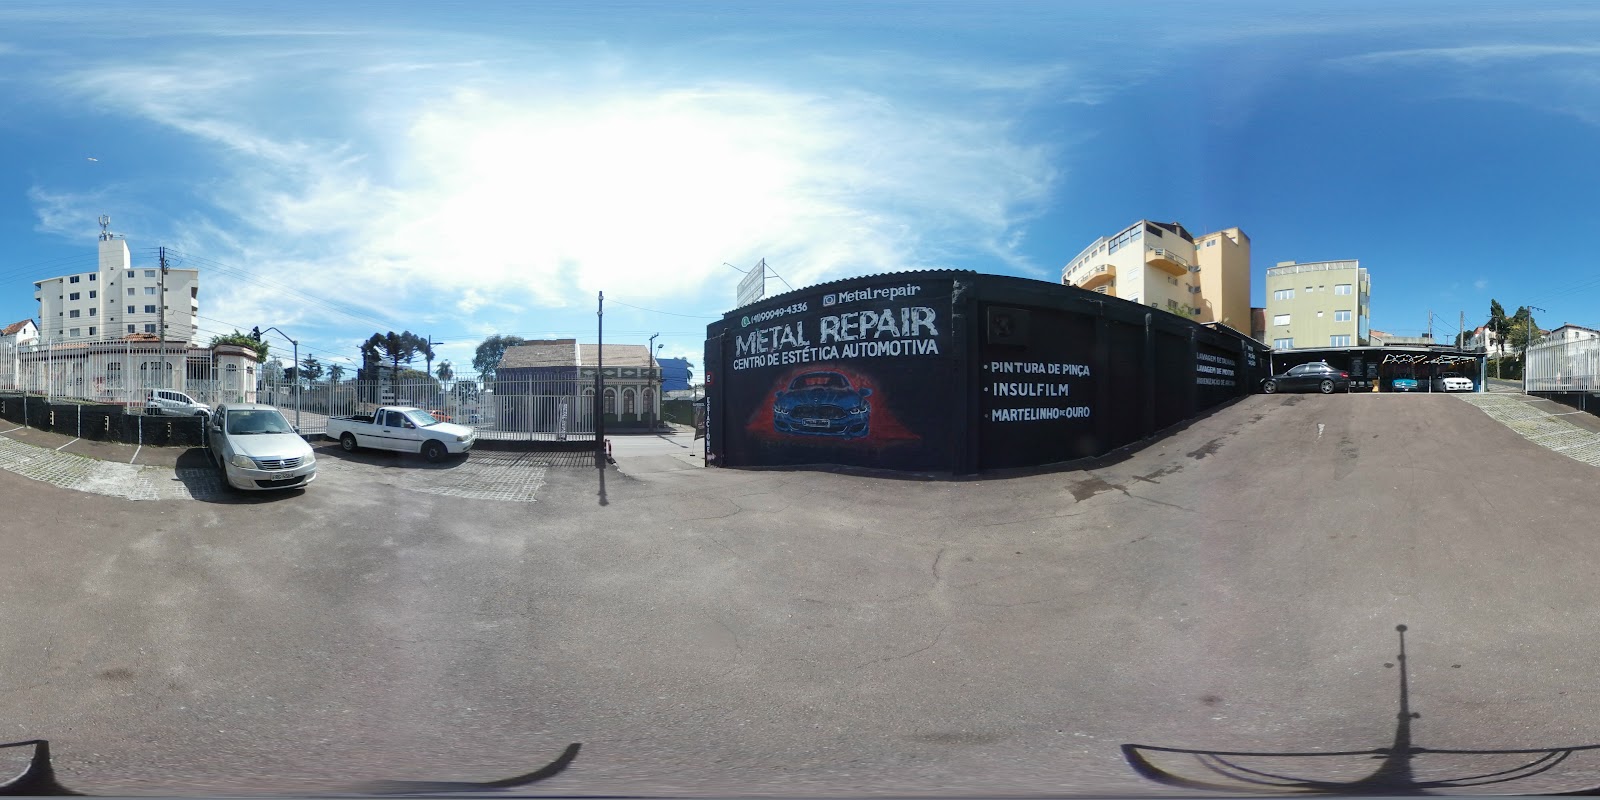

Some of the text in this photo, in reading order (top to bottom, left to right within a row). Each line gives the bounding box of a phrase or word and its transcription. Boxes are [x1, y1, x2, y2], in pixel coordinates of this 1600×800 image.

[838, 284, 921, 303] Metalrepair
[735, 306, 939, 357] METAL REPAIR
[733, 339, 939, 371] CENTRO DE ESTÉTICA AUTOMOTIVA
[1196, 351, 1216, 362] LAVAGEM
[991, 361, 1090, 378] PINTURA DE PINÇA
[1196, 364, 1216, 374] LAVAGEM
[1216, 367, 1222, 375] DE
[993, 382, 1069, 397] INSULFILM
[991, 406, 1090, 422] MARTELINHO DE OURO
